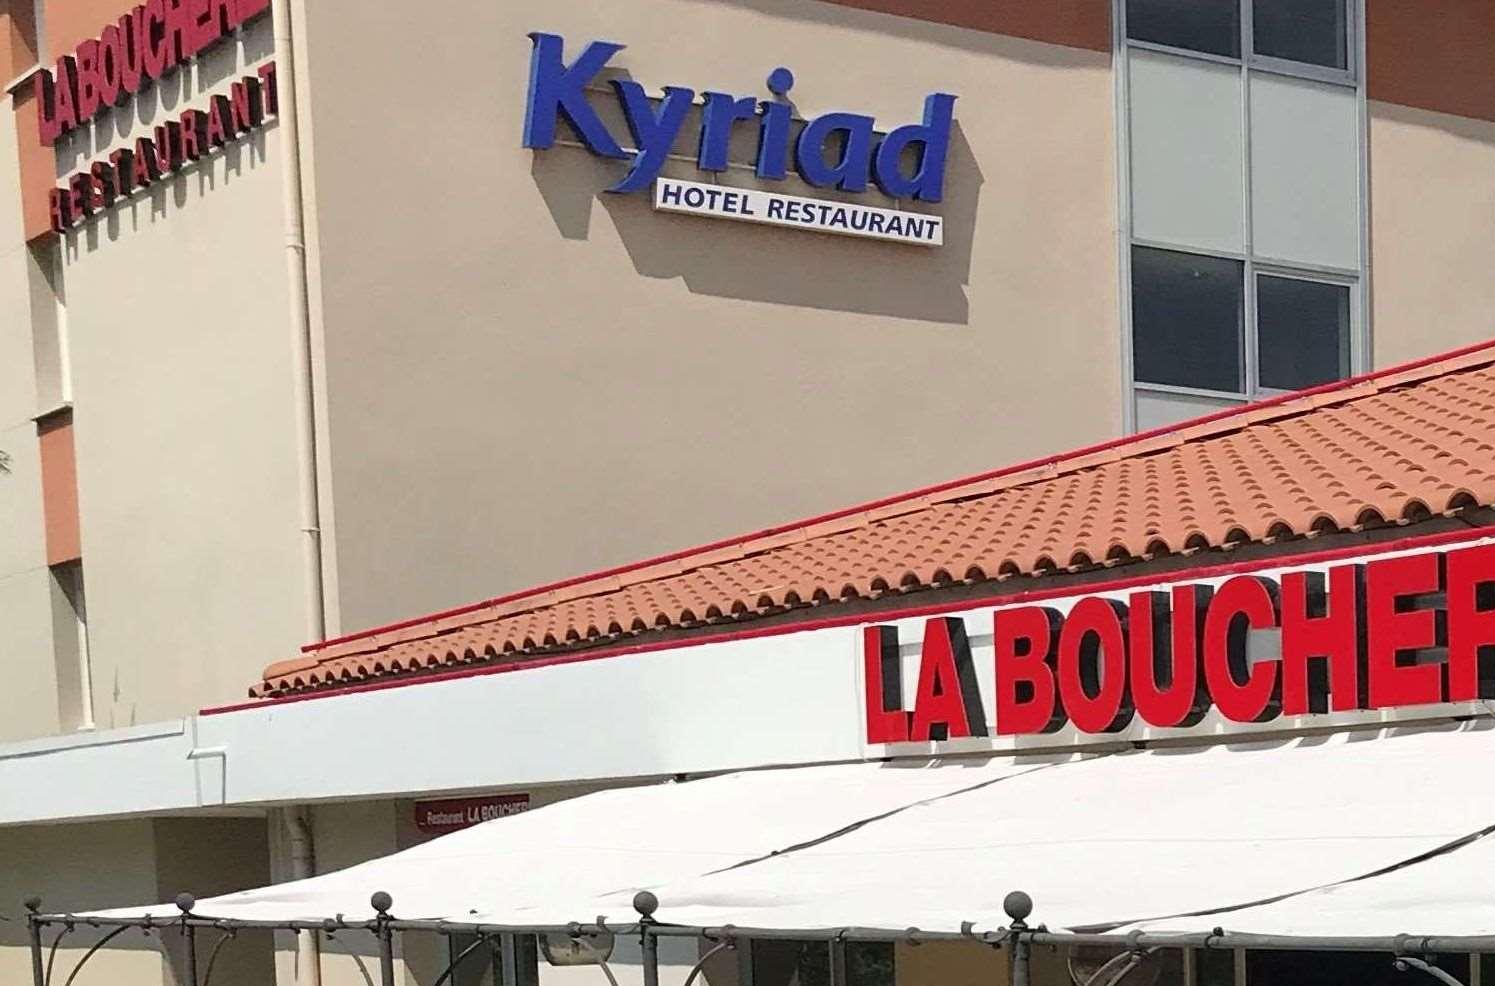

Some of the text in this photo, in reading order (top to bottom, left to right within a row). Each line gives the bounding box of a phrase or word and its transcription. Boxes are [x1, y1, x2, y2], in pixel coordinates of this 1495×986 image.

[35, 55, 80, 147] LA
[49, 60, 279, 234] RESTAURANT
[522, 32, 958, 203] Kyriad
[662, 184, 940, 240] HOTEL RESTAURANT
[865, 616, 975, 744] LA
[467, 805, 481, 822] LA
